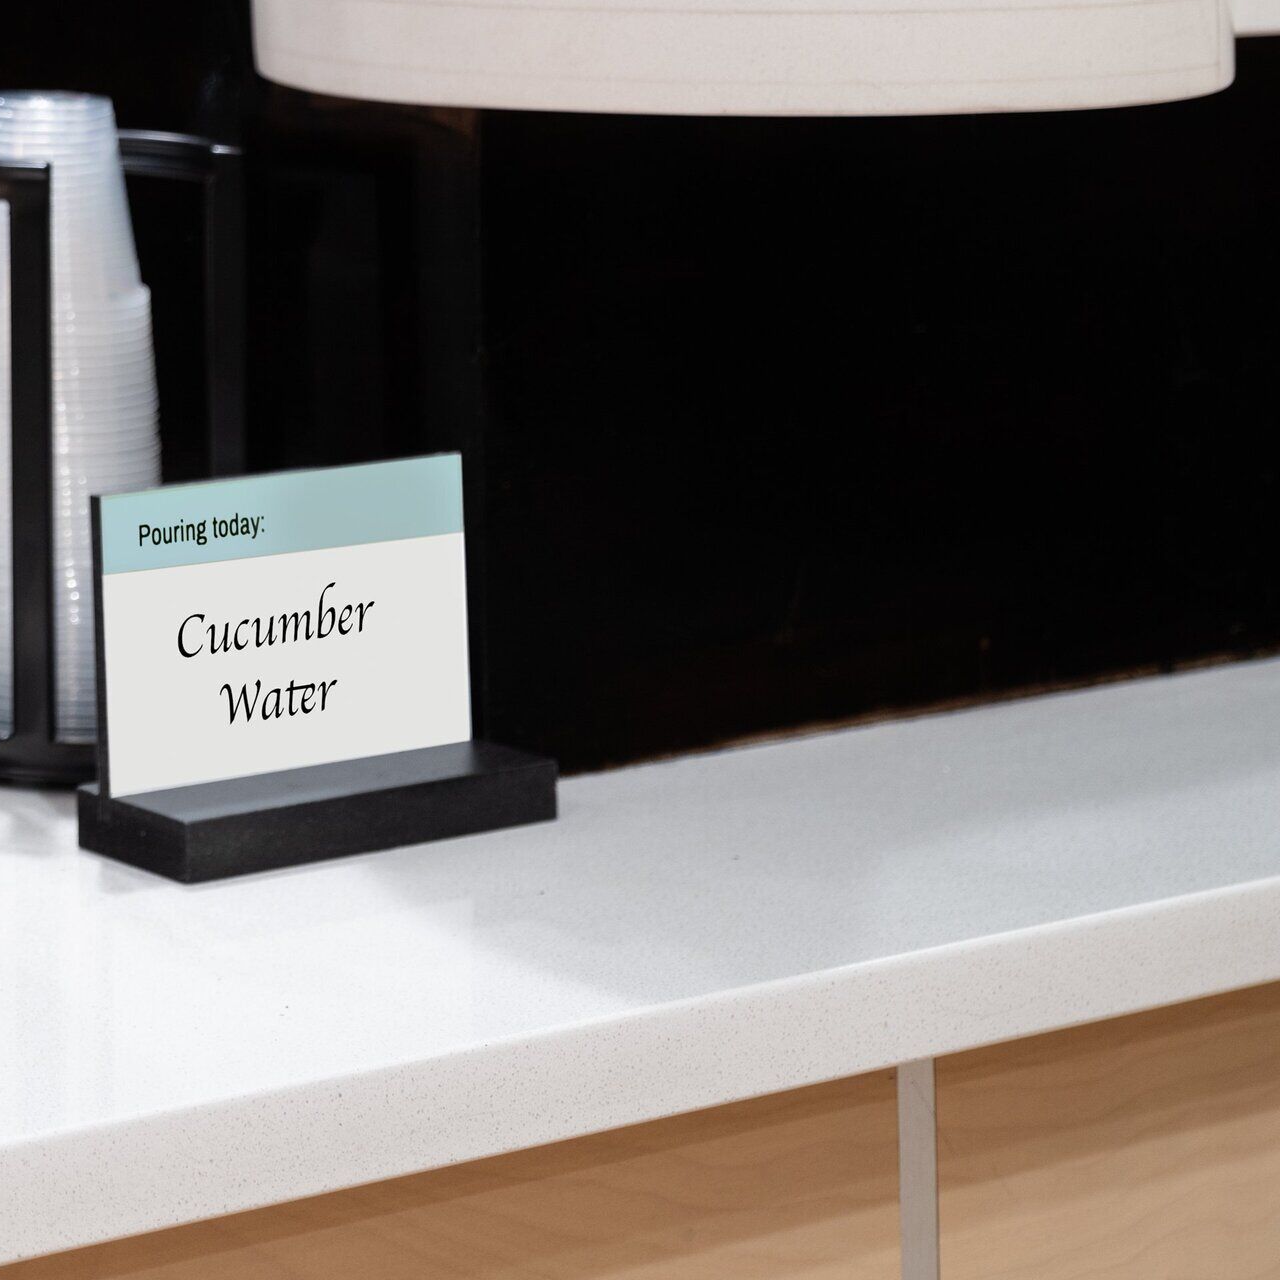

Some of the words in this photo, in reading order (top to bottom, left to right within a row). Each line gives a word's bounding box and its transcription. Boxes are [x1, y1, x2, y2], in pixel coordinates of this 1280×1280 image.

[138, 518, 208, 547] Pouring
[212, 512, 266, 540] today:
[176, 581, 375, 658] Cucumber
[219, 679, 338, 725] Water
